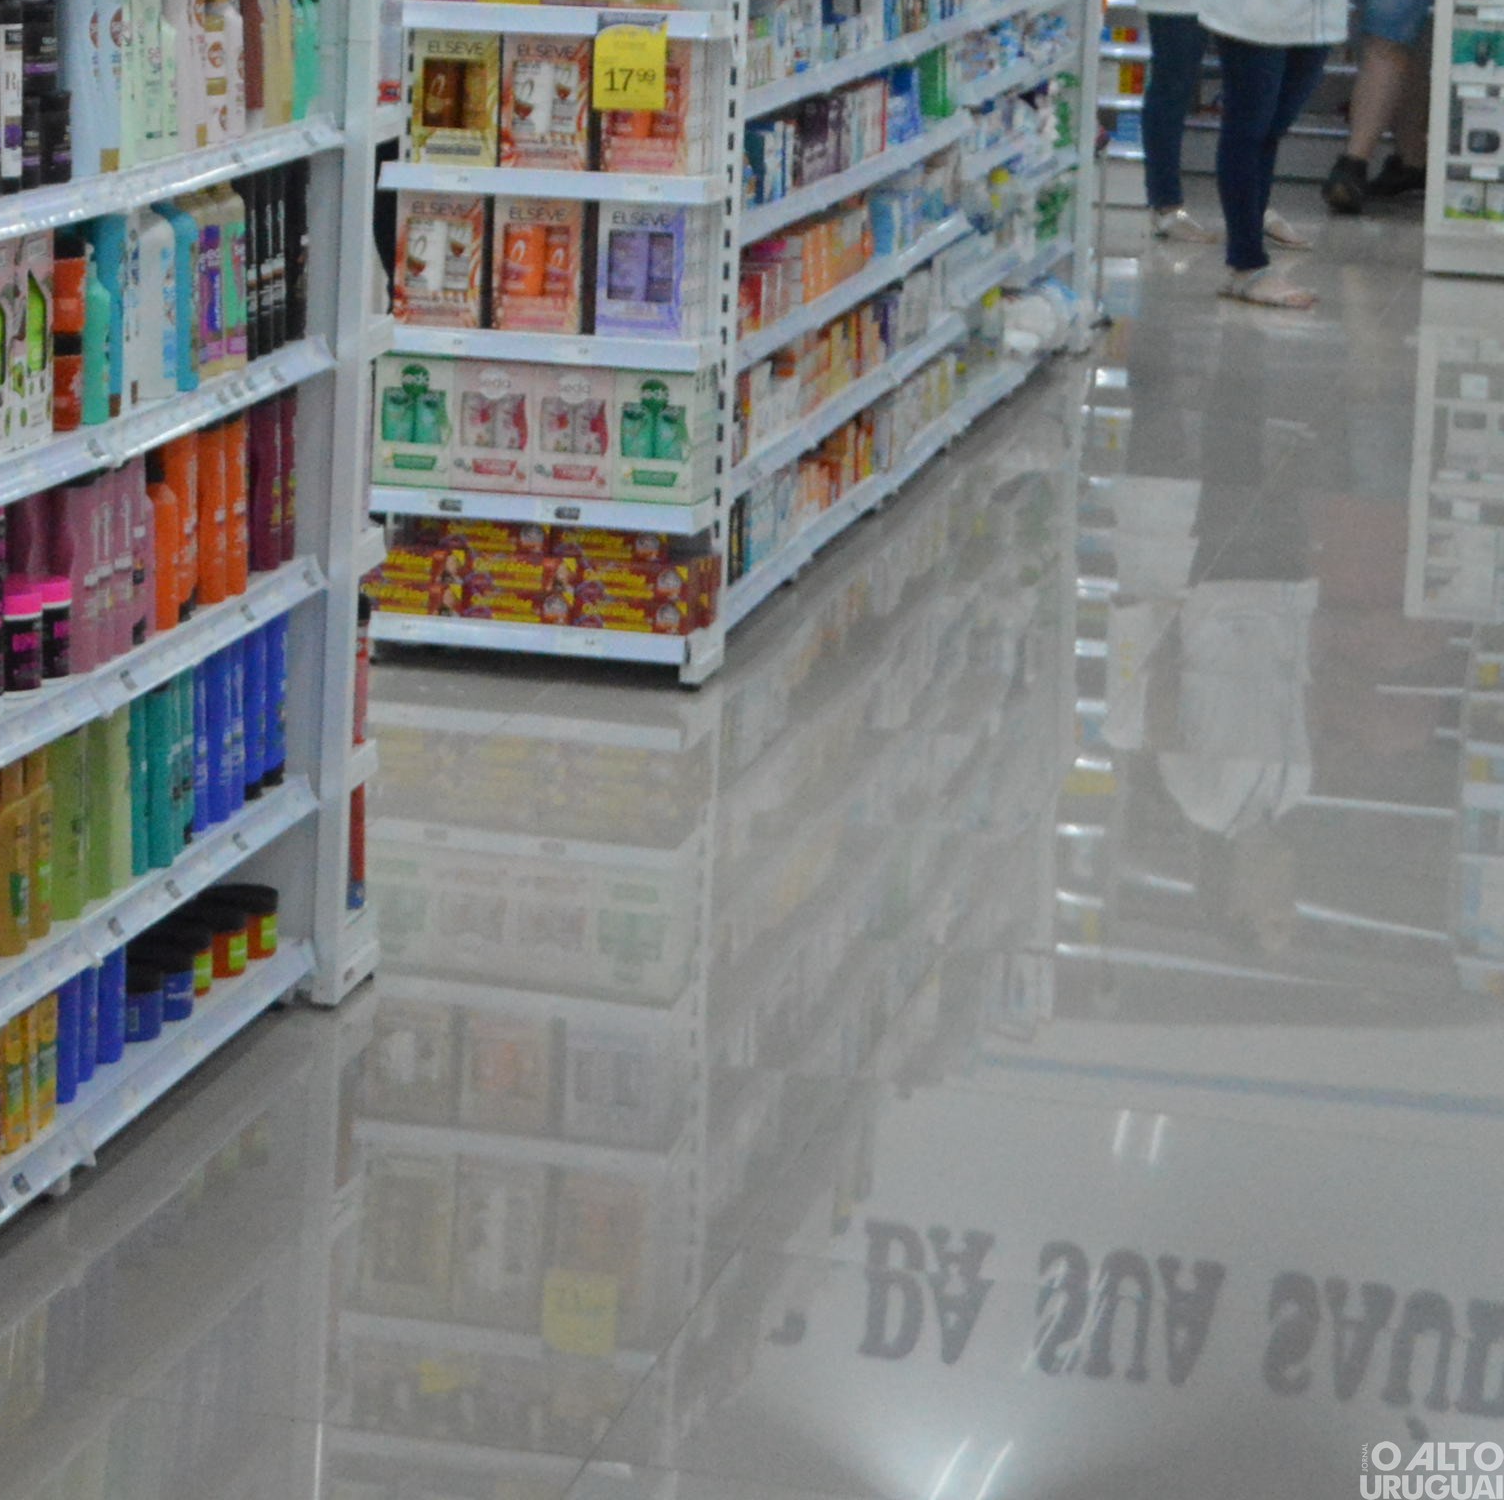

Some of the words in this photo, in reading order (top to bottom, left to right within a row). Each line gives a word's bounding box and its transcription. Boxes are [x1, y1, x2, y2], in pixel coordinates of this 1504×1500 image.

[428, 41, 483, 53] ELSEVE
[517, 43, 577, 56] ELSEVE
[413, 202, 468, 215] ELSEVE
[509, 207, 566, 220] ELSEVE
[612, 211, 670, 226] ELSEVE
